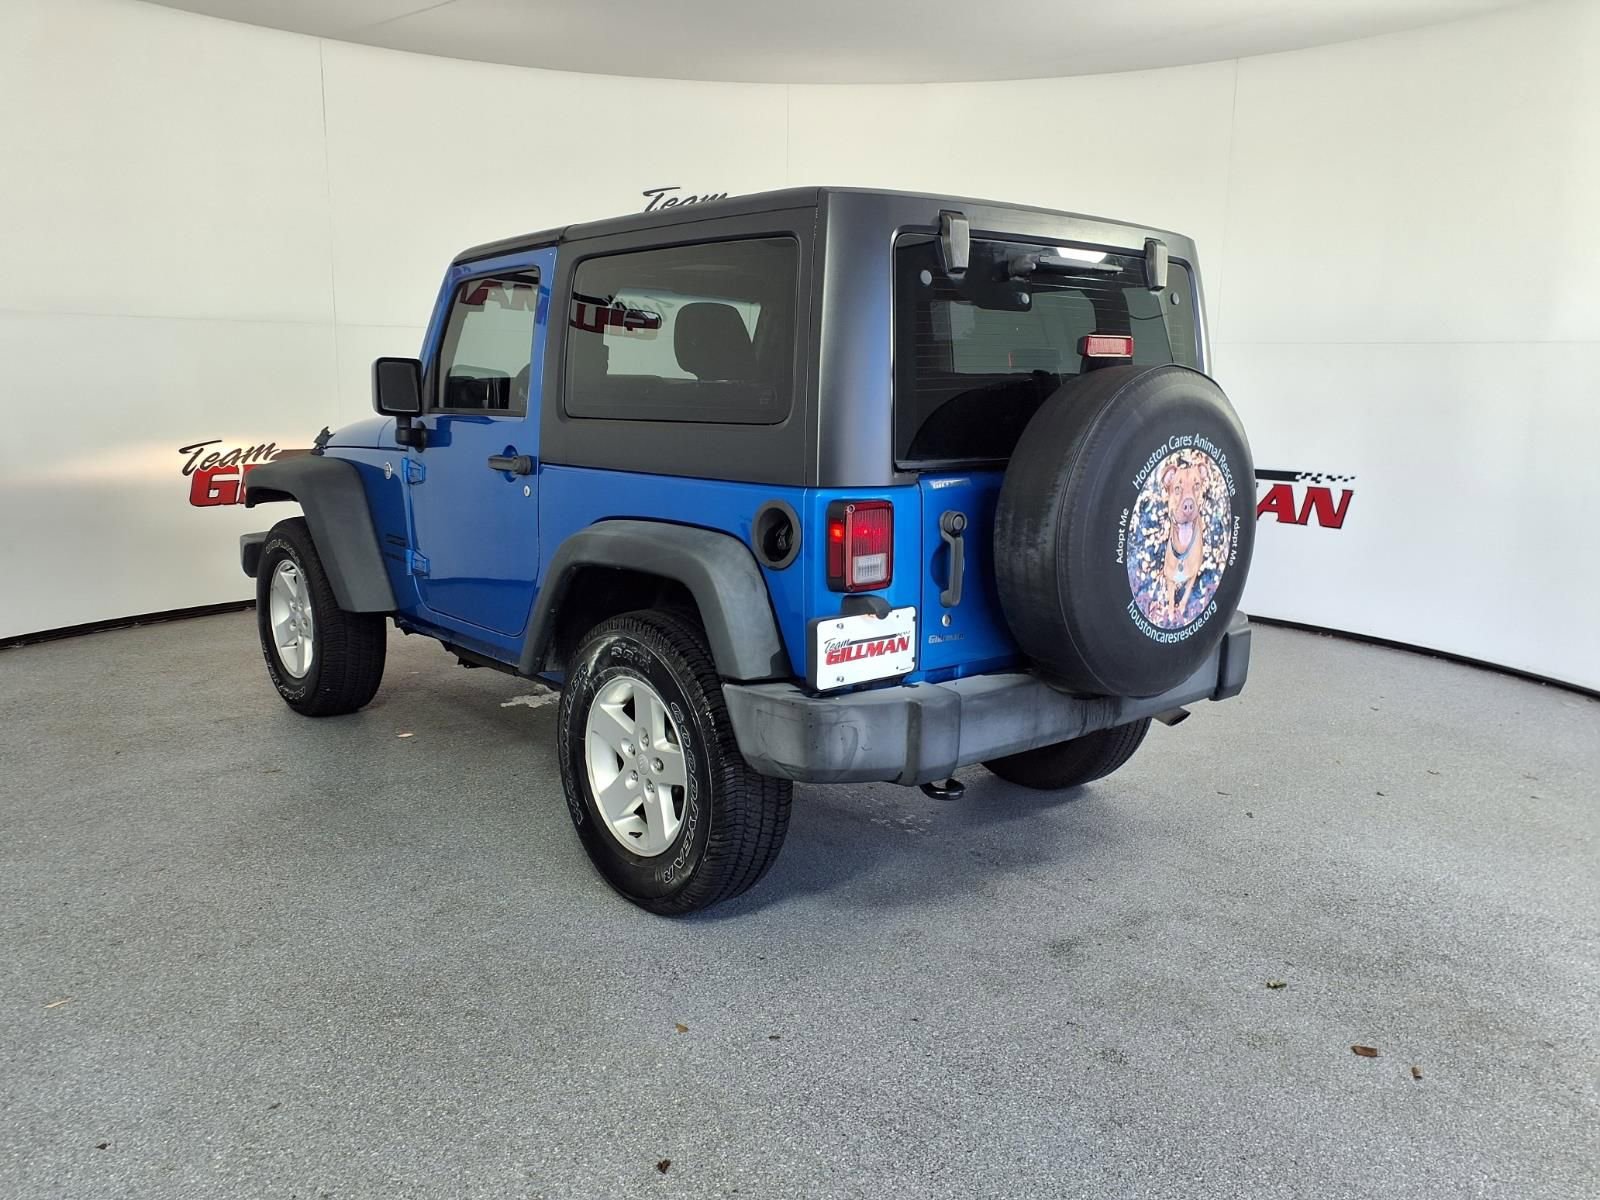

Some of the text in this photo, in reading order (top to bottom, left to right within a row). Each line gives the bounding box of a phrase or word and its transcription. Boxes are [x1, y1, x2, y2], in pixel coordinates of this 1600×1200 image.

[178, 439, 281, 477] Team
[1132, 433, 1236, 497] Houston Cares Animal Rescue
[1116, 508, 1129, 564] Adopt Me
[1229, 515, 1241, 566] Adopt Me
[1127, 600, 1217, 643] houstoncaresrescue.org
[824, 637, 850, 654] Team
[826, 636, 910, 665] GILLMAN
[663, 701, 699, 884] GOODYEAR
